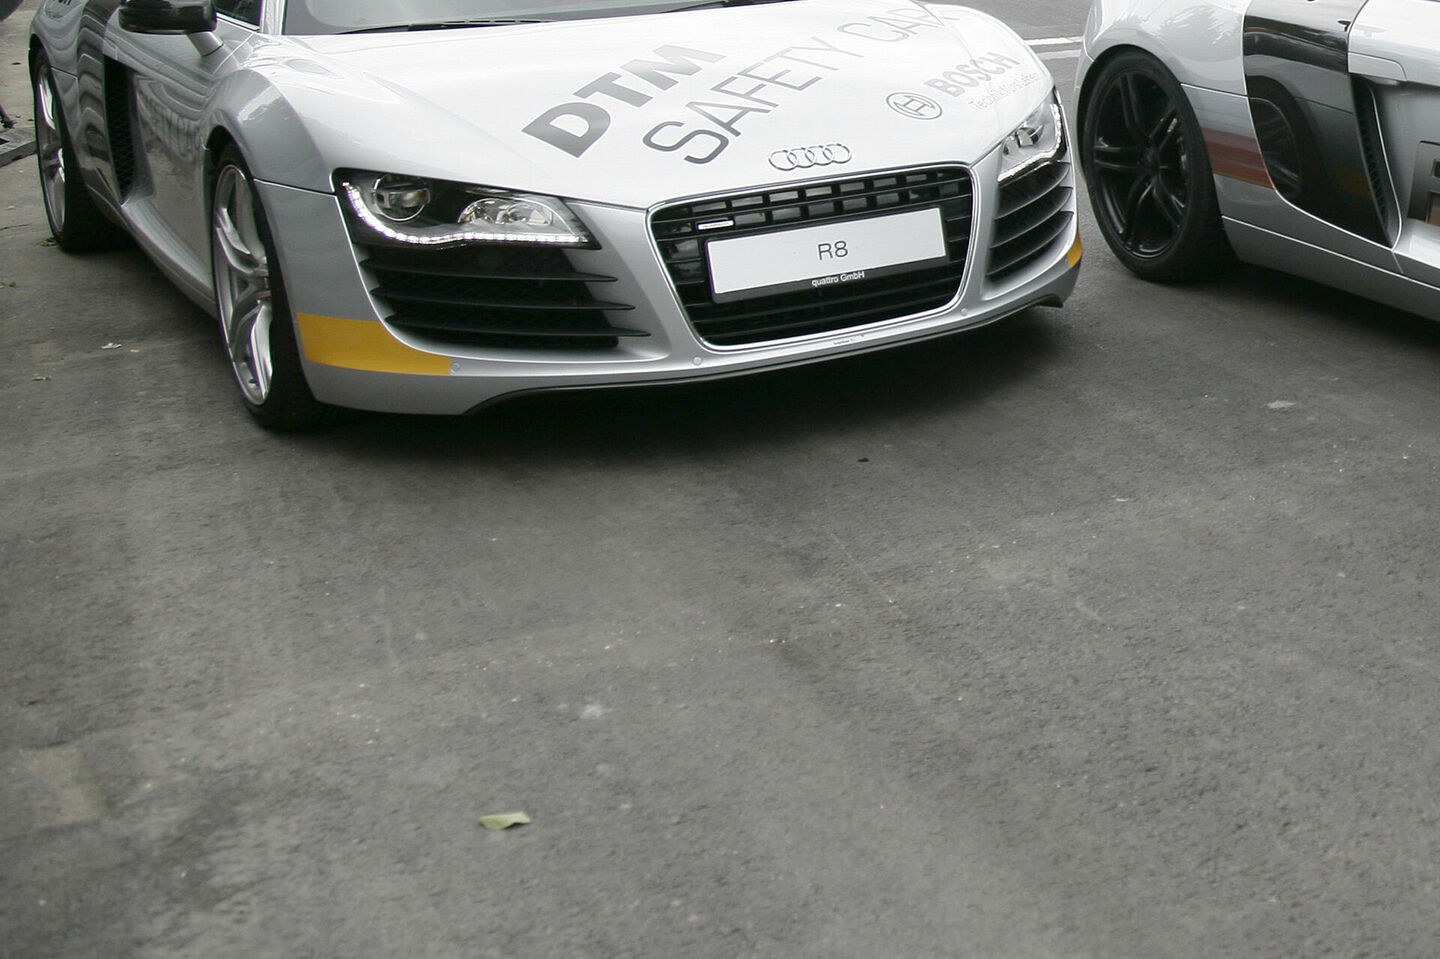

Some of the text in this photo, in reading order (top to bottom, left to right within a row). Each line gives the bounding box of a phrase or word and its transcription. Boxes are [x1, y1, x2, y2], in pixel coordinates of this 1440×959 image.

[642, 6, 960, 164] SAFETY CAR
[923, 51, 1021, 98] BOSCH
[520, 43, 727, 159] DTM
[817, 240, 849, 260] R8
[811, 271, 865, 287] quattro GmbH
